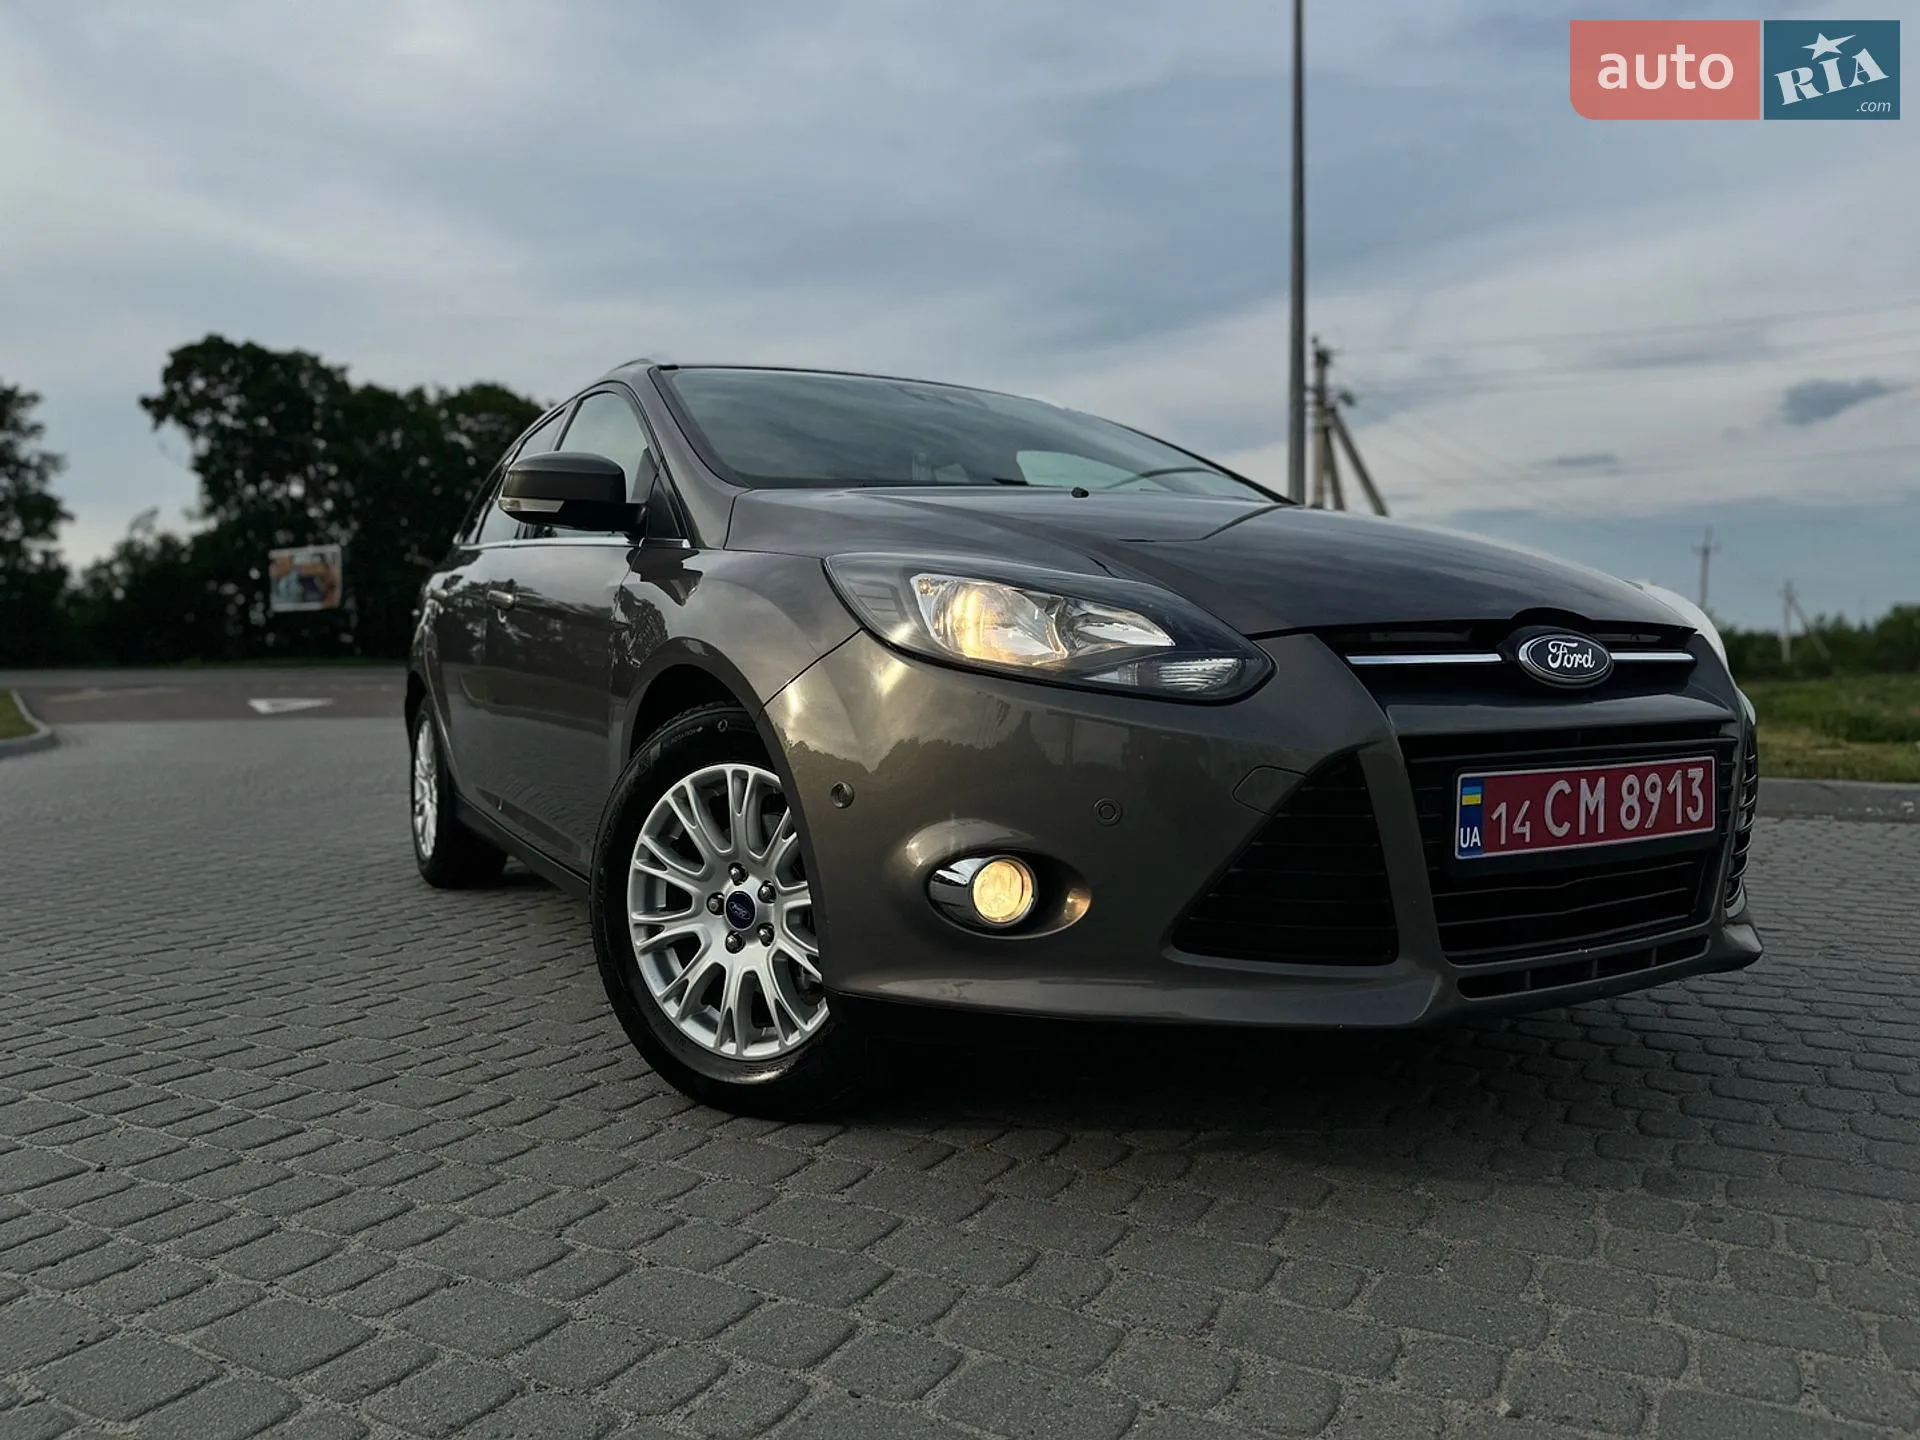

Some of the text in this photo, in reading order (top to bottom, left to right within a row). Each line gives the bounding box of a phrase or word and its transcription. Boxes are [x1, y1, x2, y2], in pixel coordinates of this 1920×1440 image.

[1547, 640, 1596, 669] Ford
[1490, 767, 1704, 845] 14 CM 8913
[1459, 826, 1482, 848] UA
